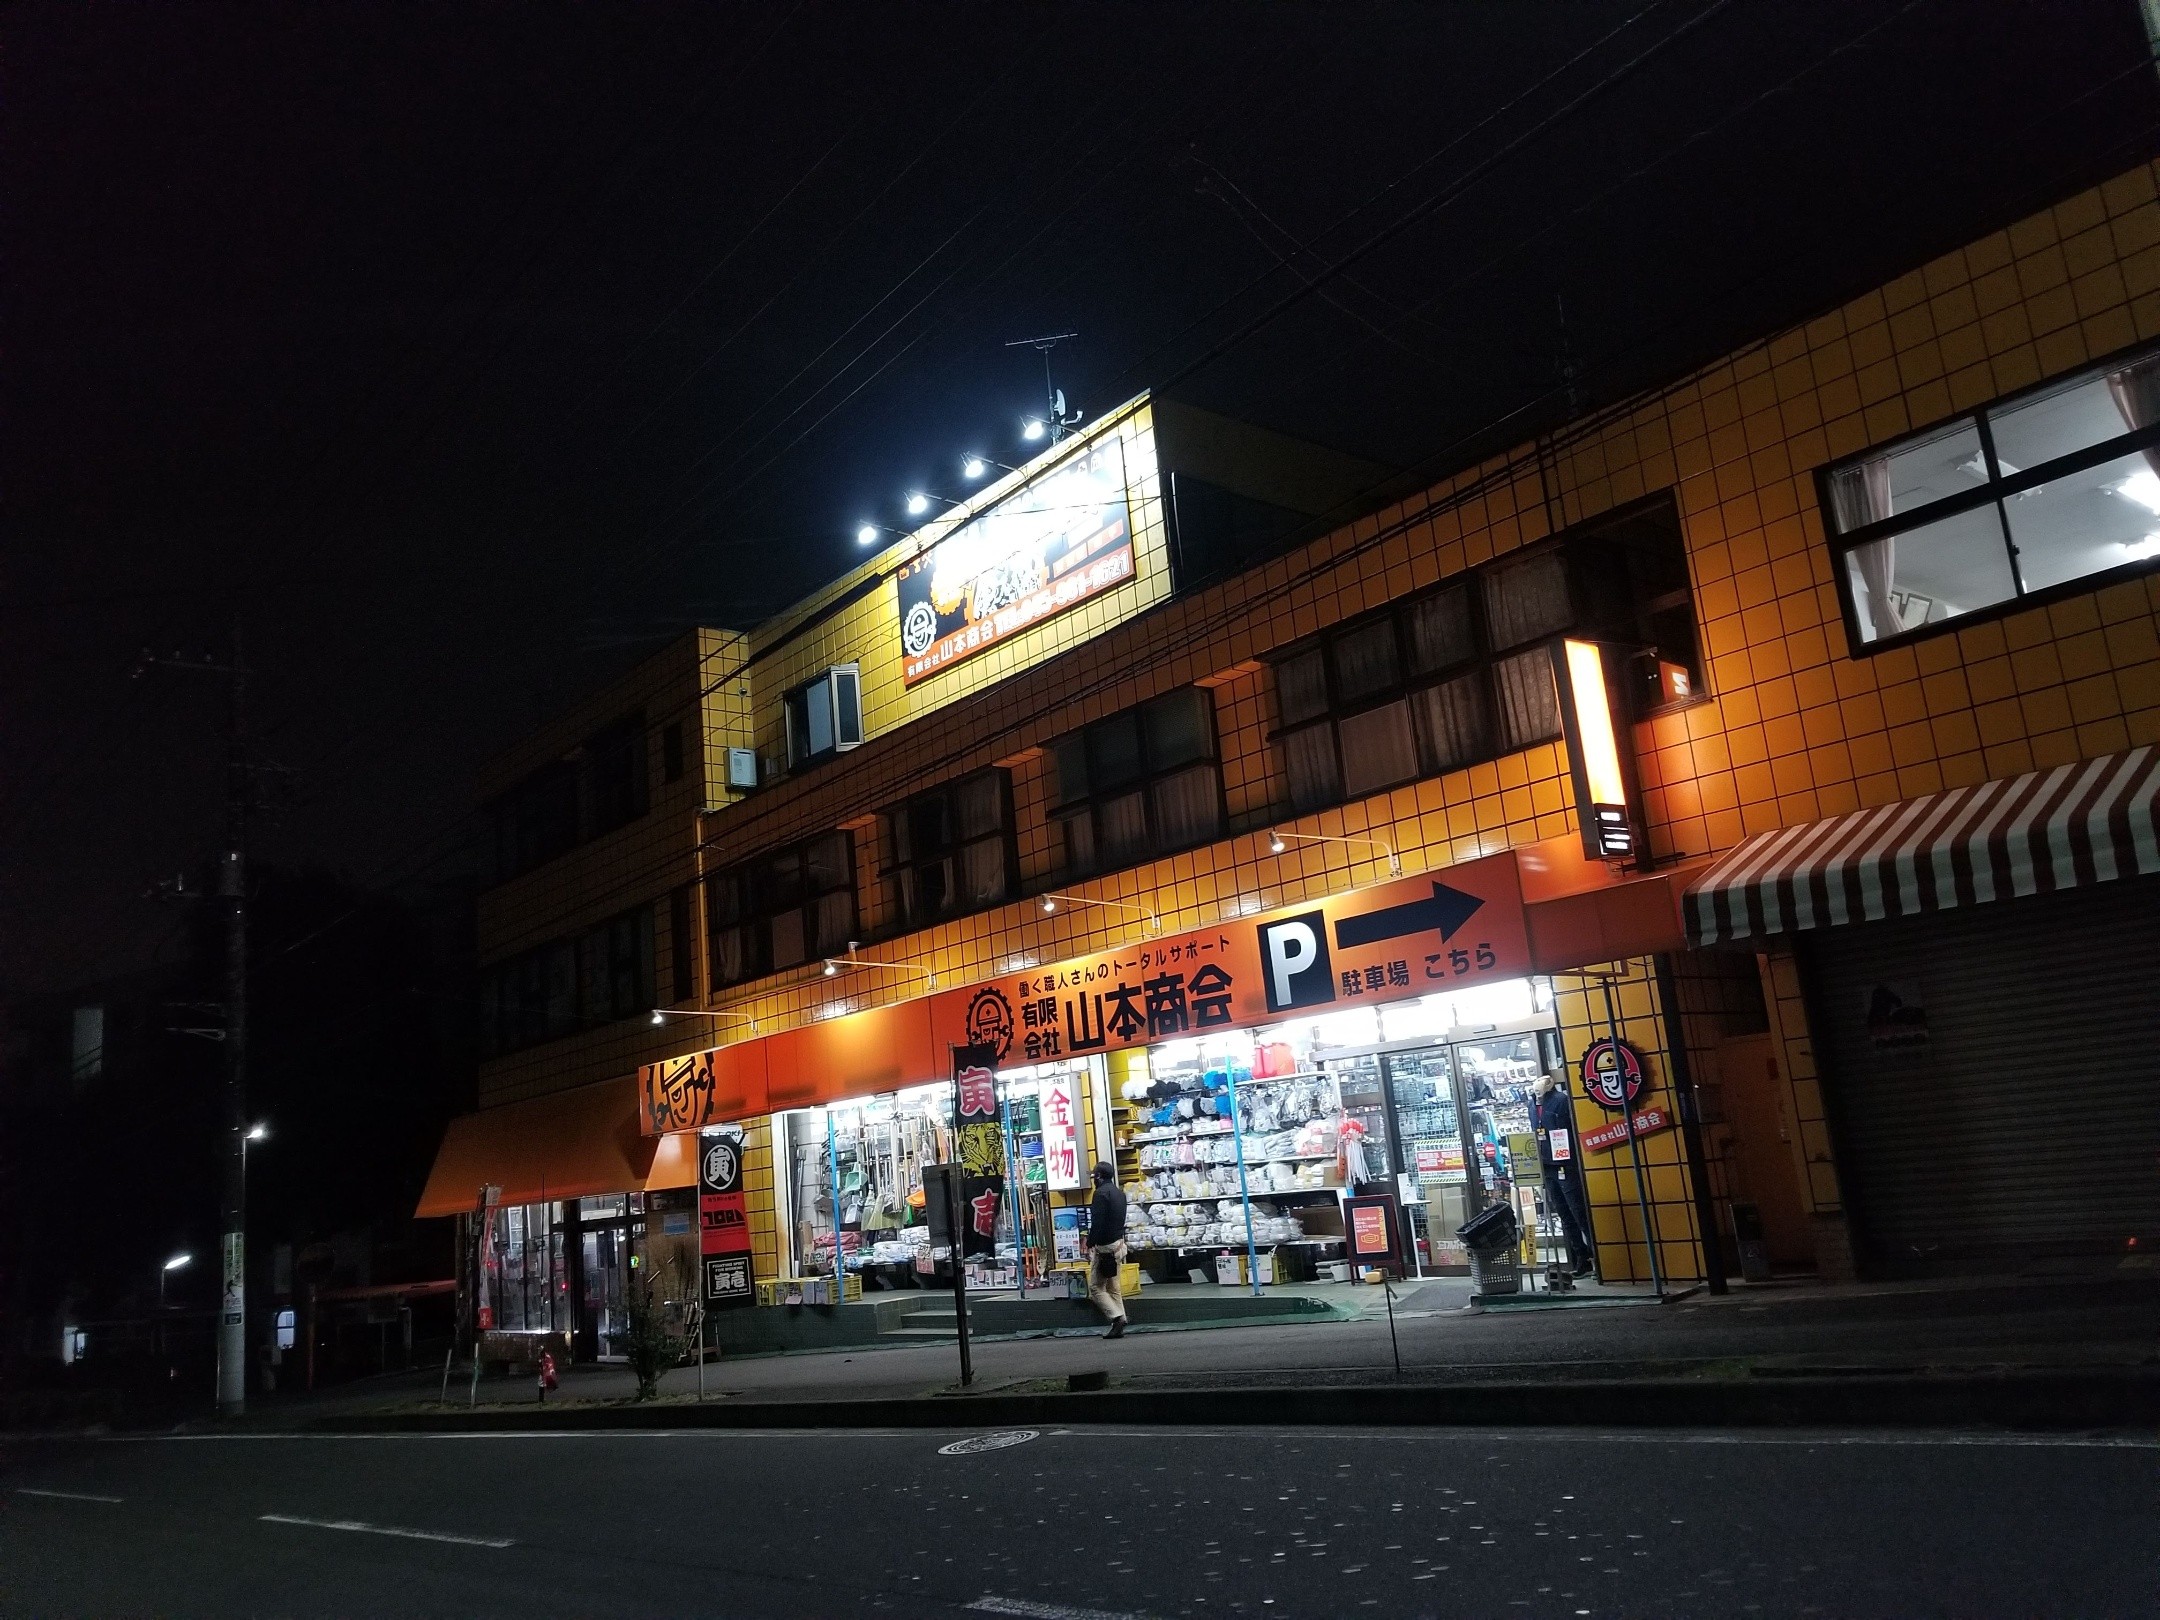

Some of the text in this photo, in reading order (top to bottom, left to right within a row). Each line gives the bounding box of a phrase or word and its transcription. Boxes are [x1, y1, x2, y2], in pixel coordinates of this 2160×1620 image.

[1019, 935, 1230, 998] 働く職人さんのトータルサポート
[1267, 921, 1317, 1006] P
[1341, 943, 1497, 996] 駐車場 こちら
[1022, 996, 1059, 1029] 有限
[1065, 964, 1233, 1052] 山本商会
[1024, 1027, 1062, 1060] 会社
[1044, 1088, 1075, 1179] 金物
[708, 1147, 731, 1182] 寅
